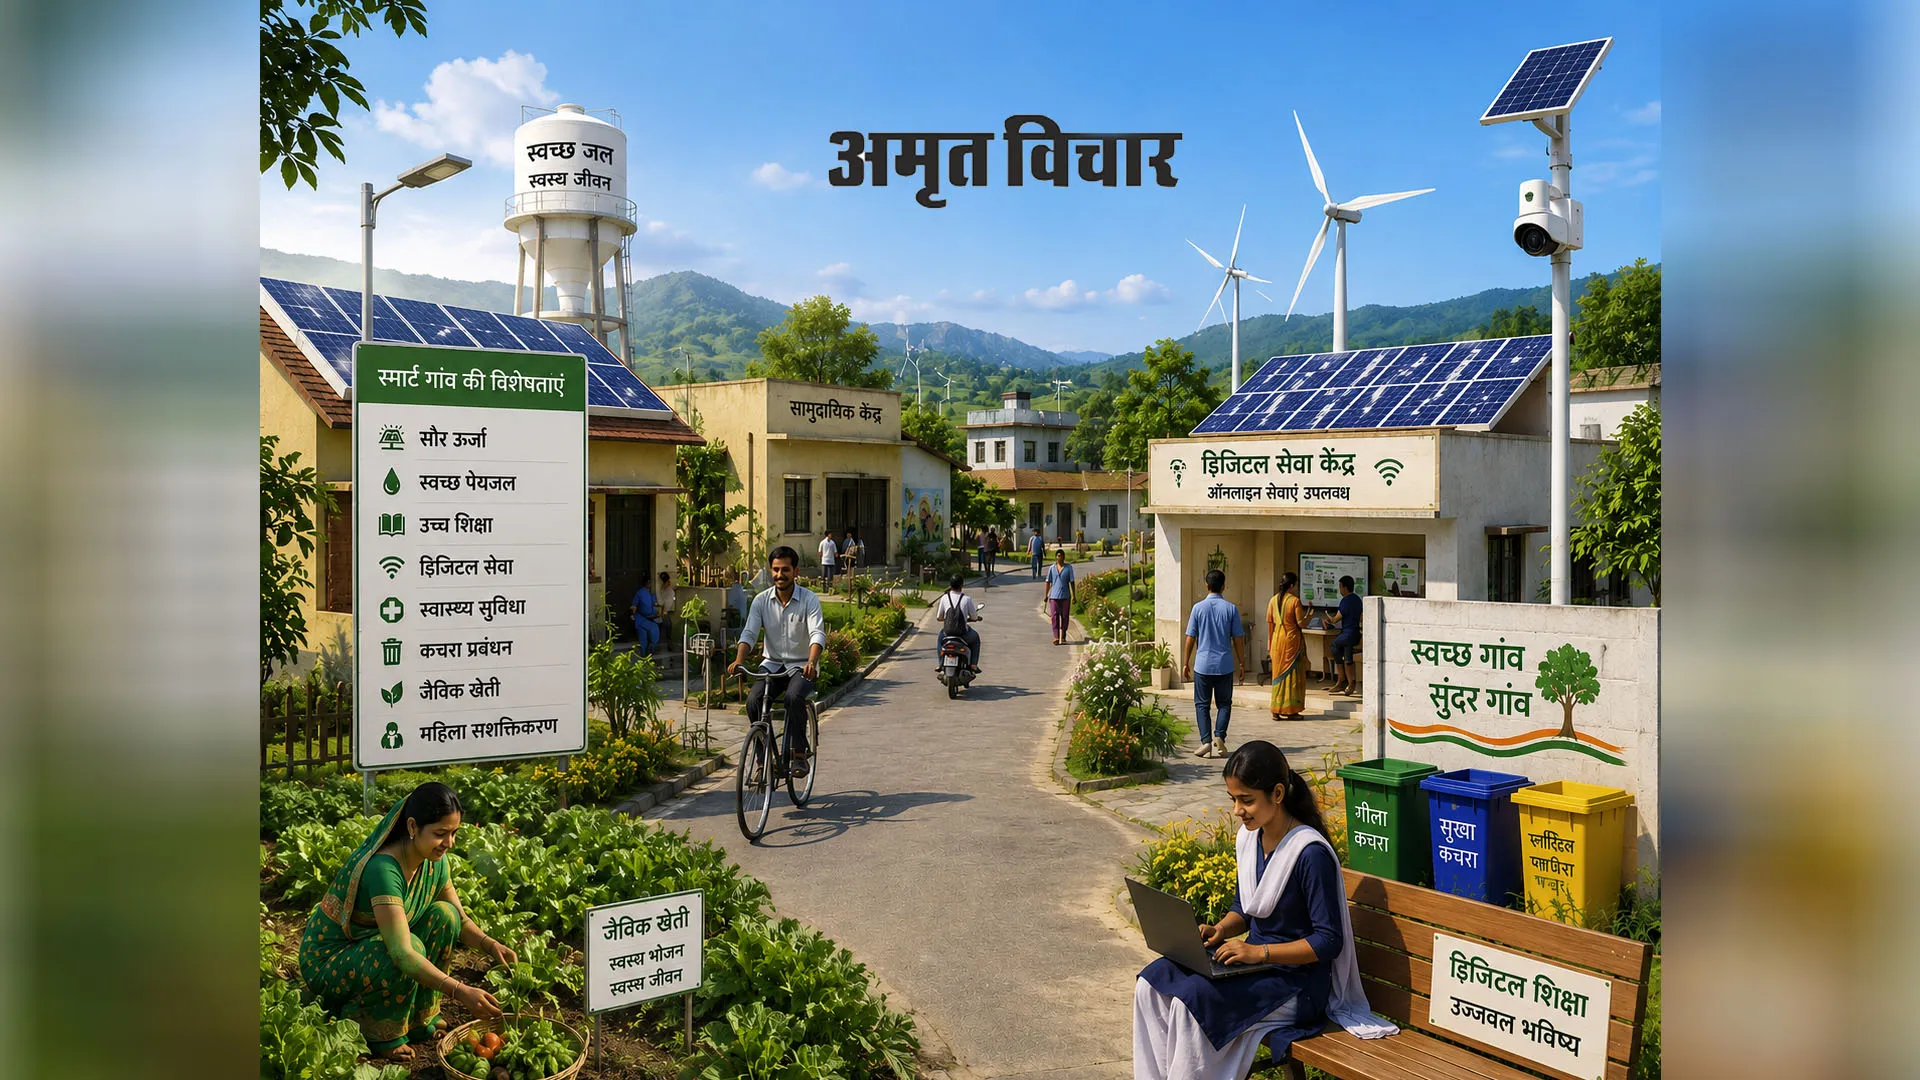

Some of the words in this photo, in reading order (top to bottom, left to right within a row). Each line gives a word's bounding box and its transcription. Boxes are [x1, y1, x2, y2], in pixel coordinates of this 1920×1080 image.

[527, 142, 576, 161] स्वच्छ
[582, 143, 614, 165] जल
[574, 168, 612, 191] जीवन
[378, 365, 419, 387] स्मार्ट
[425, 367, 457, 389] गांव
[462, 369, 486, 390] की
[490, 370, 565, 397] विशेषताएं
[790, 399, 855, 423] सामुदायिक
[419, 425, 448, 447] सौर
[453, 427, 487, 447] ऊर्जा
[1201, 449, 1270, 477] डिजिटल
[1276, 448, 1313, 473] सेवा
[419, 475, 461, 490] स्वच्छ
[465, 470, 516, 490] पेयजल
[1208, 483, 1262, 502] ऑनलाइन
[1265, 483, 1299, 502] सेवाएं
[420, 518, 450, 533] उच्च
[454, 512, 493, 534] शिक्षा
[419, 555, 479, 578] डिजिटल
[484, 555, 513, 575] सेवा
[478, 595, 526, 621] सुविधा
[420, 643, 462, 658] कचरा
[467, 637, 513, 657] प्रबंधन
[1410, 640, 1473, 667] स्वच्छ
[1480, 637, 1525, 671] गांव
[419, 680, 464, 700] जैविक
[469, 677, 501, 697] खेती
[1429, 677, 1480, 719] सुंदर
[1486, 683, 1533, 717] गांव
[420, 721, 467, 743] महिला
[471, 717, 558, 738] सशक्तिकरण
[1355, 802, 1387, 826] गीला
[1354, 831, 1388, 852] कचरा
[1439, 846, 1478, 868] कचरा
[602, 916, 652, 940] जैविक
[656, 906, 690, 931] खेती
[649, 944, 685, 962] भोजन
[649, 968, 683, 986] जीवन
[1450, 949, 1528, 999] डिजिटल
[1533, 973, 1590, 1017] शिक्षा
[1449, 996, 1516, 1035] उज्जवल
[1520, 1019, 1581, 1058] भविष्य
